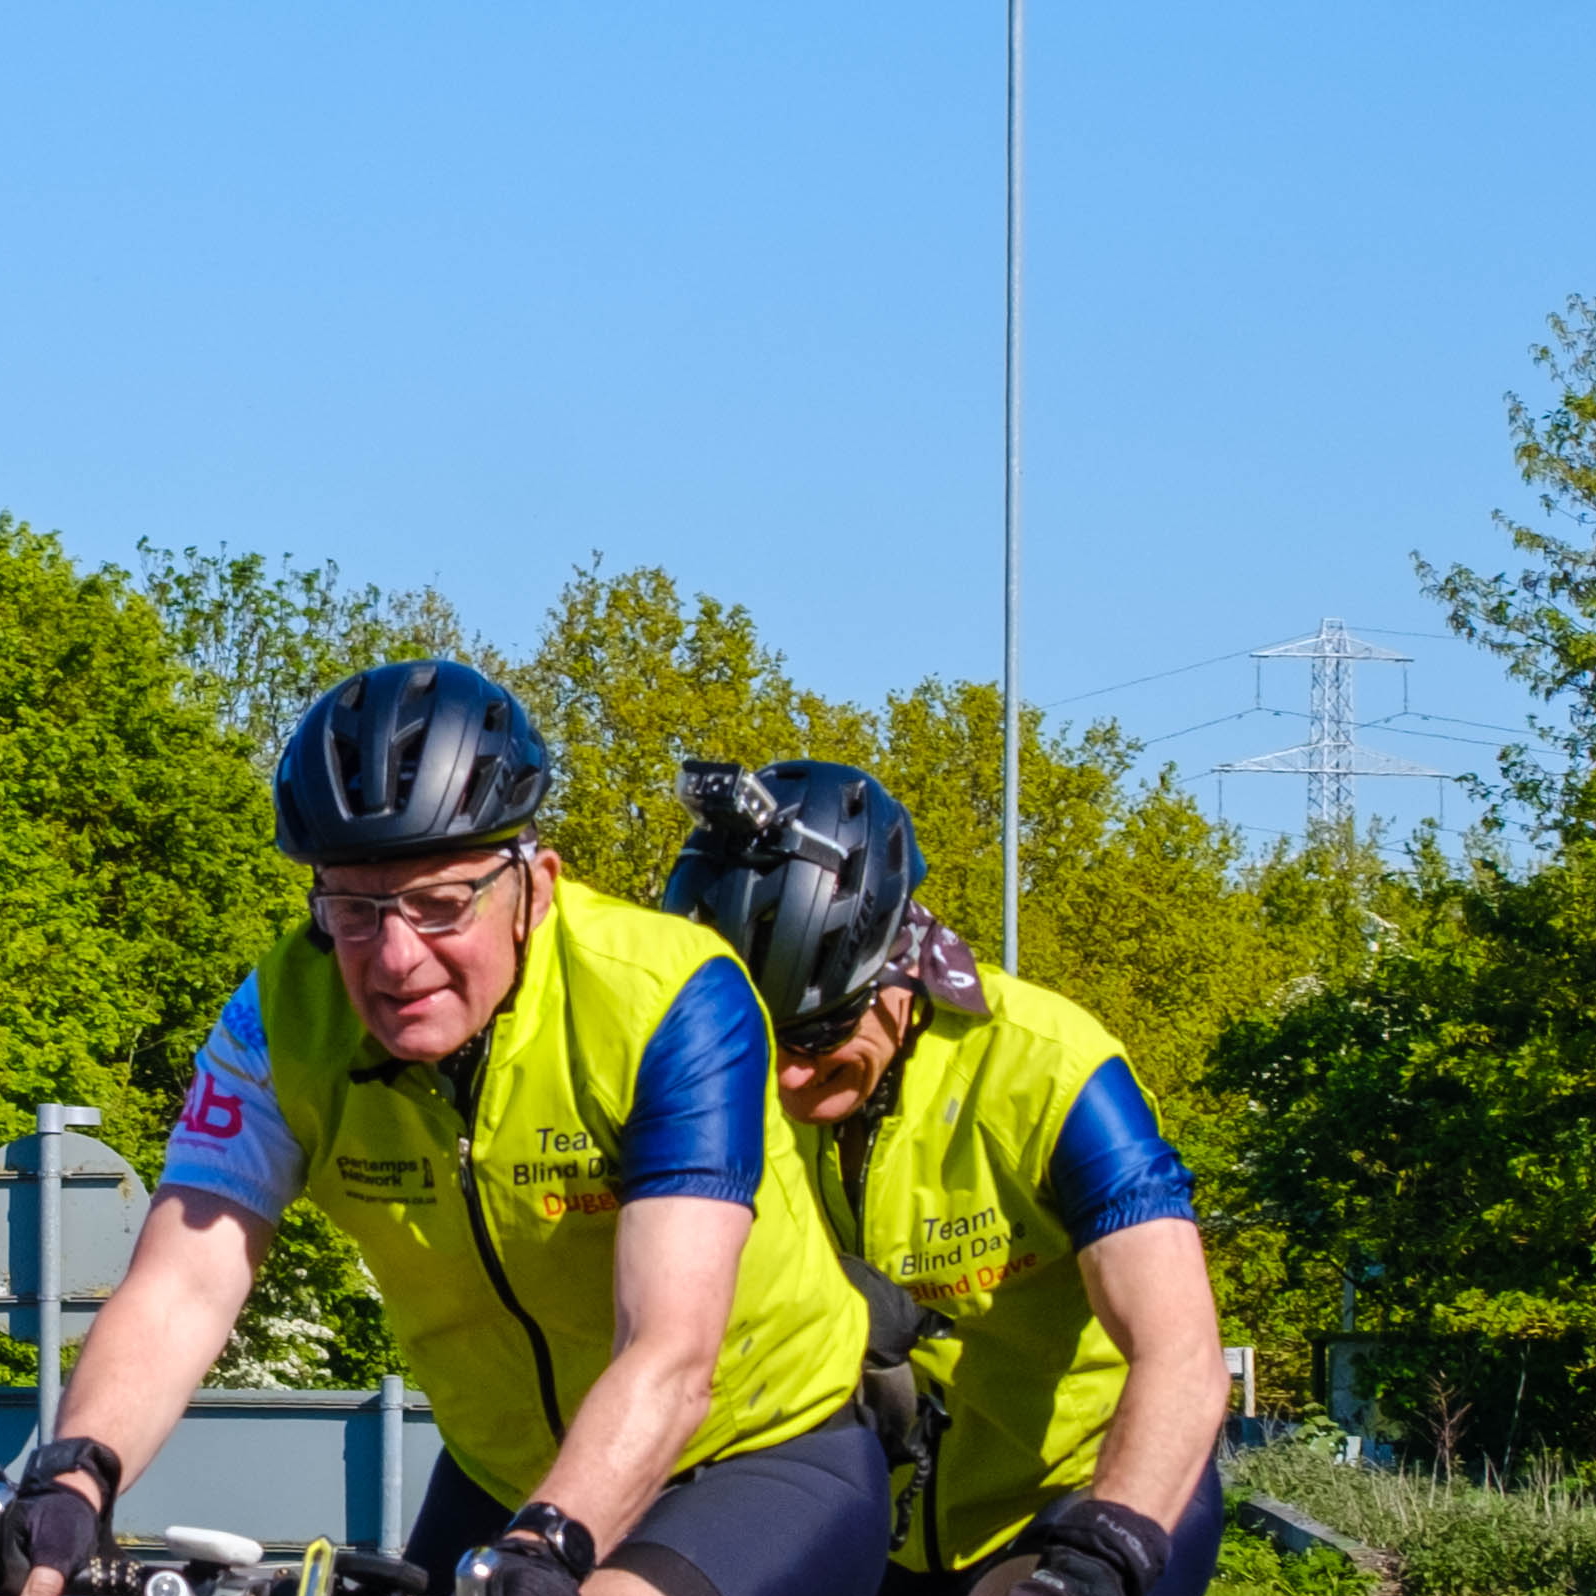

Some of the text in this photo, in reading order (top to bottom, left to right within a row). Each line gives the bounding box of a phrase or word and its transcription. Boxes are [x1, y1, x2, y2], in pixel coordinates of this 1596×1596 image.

[536, 1127, 588, 1154] Tea
[513, 1157, 621, 1186] Blind Da
[543, 1191, 617, 1216] Dugg
[923, 1206, 996, 1243] Team
[900, 1221, 1026, 1276] Blind Dave
[976, 1252, 1036, 1289] Dave
